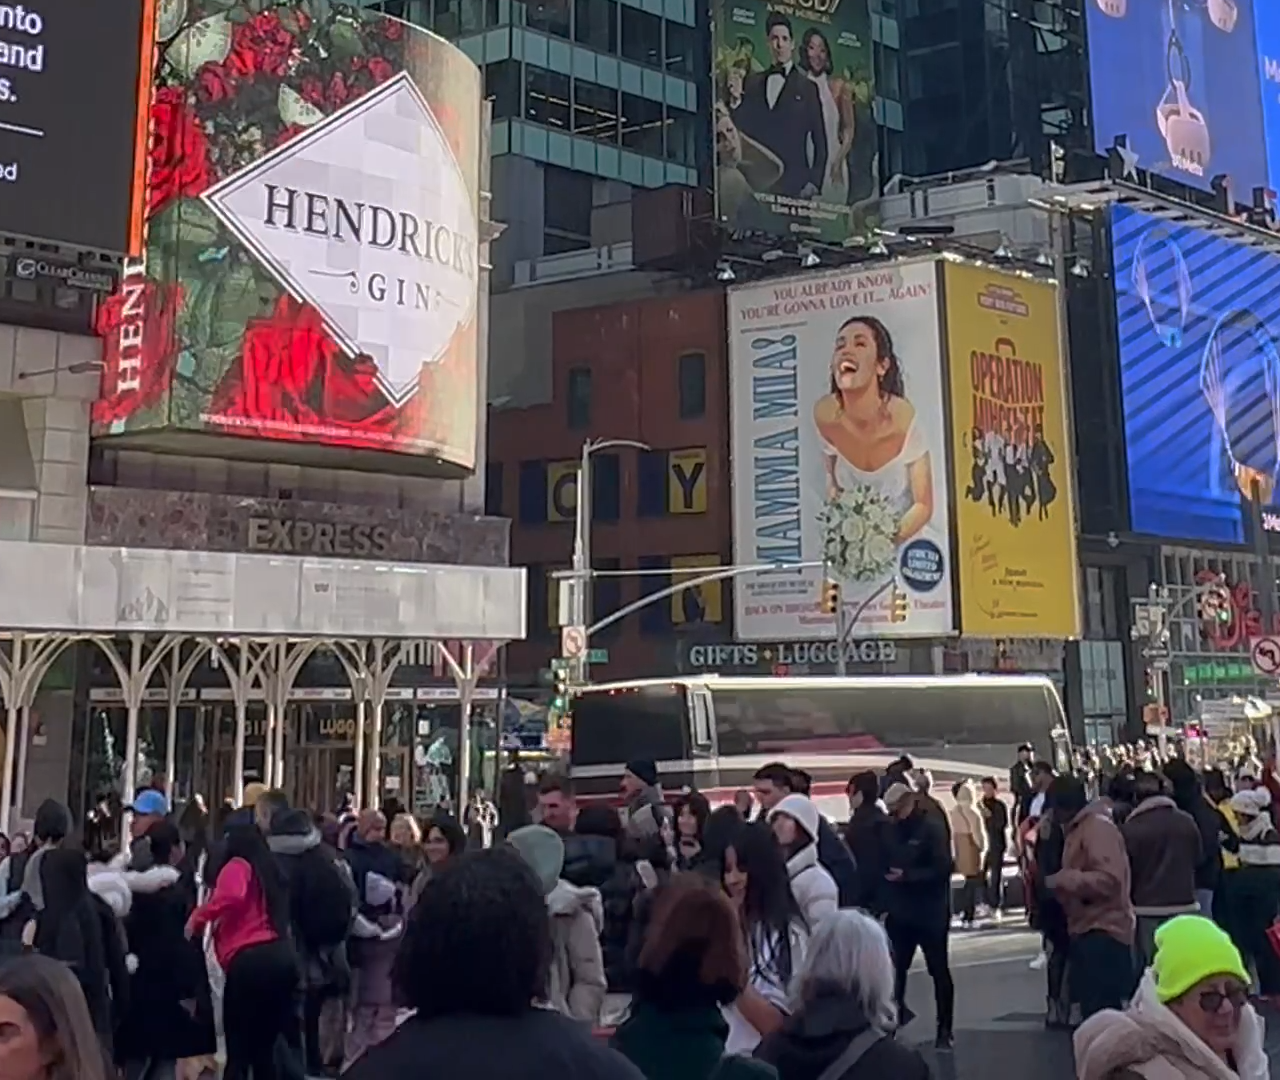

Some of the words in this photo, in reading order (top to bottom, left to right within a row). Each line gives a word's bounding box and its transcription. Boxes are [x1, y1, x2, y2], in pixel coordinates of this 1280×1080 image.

[367, 271, 431, 311] GIN
[740, 304, 781, 321] YOU'RE
[783, 298, 827, 316] GONNA
[829, 292, 862, 310] LOVE
[774, 285, 798, 301] YOU
[800, 278, 855, 299] ALREADY
[857, 273, 894, 291] KNOW
[750, 333, 799, 423] MIA!
[970, 349, 1045, 405] OPERATION
[671, 461, 705, 510] Y
[754, 426, 804, 576] MAMMA
[247, 517, 392, 557] EXPRESS
[689, 643, 758, 667] GIFTS
